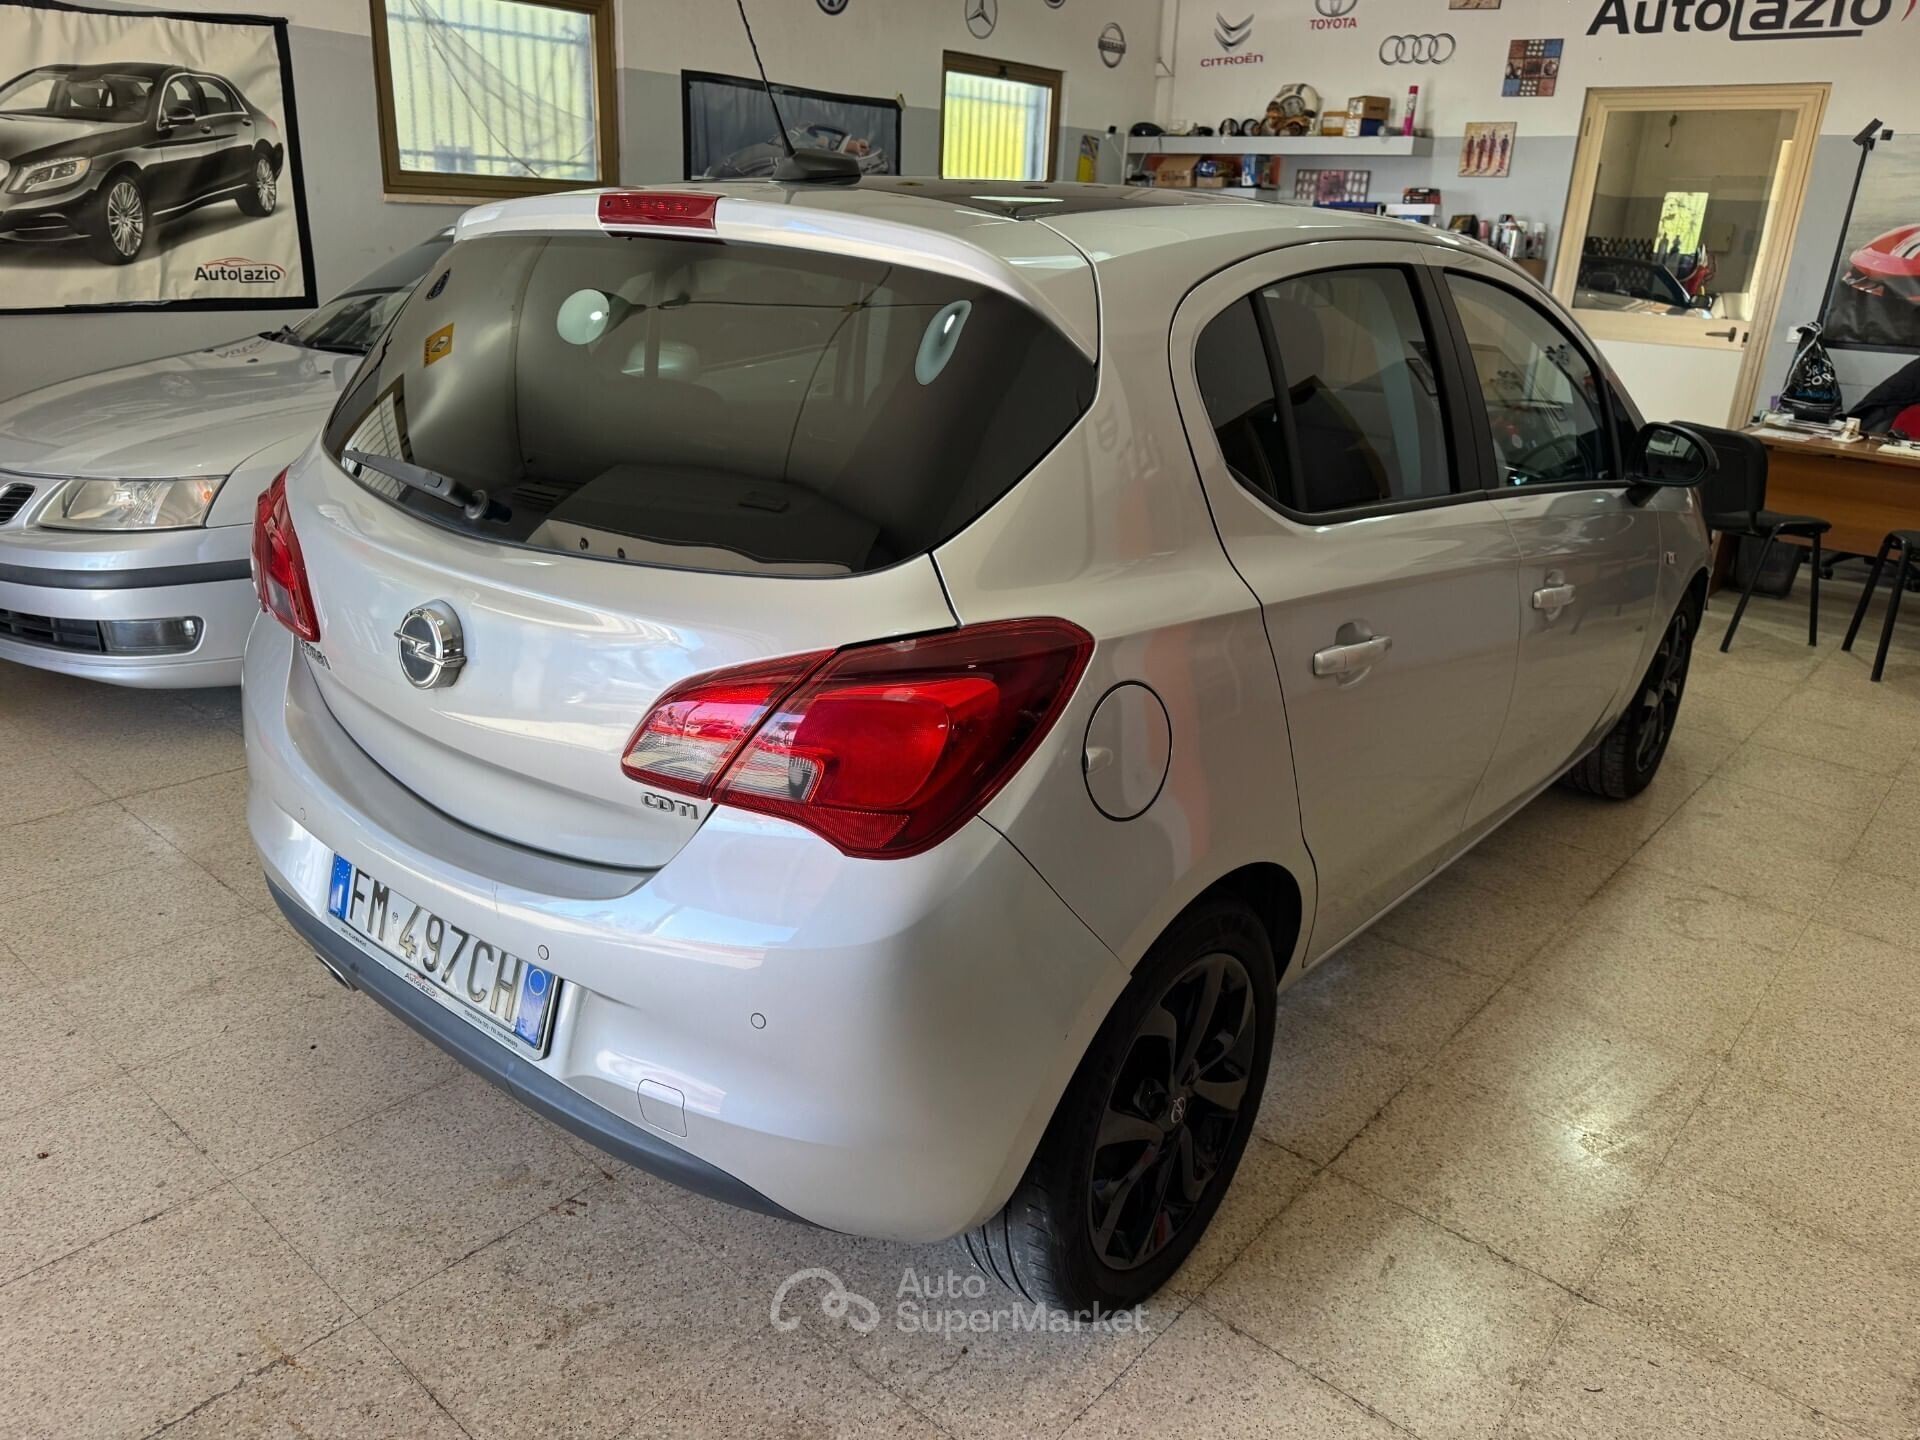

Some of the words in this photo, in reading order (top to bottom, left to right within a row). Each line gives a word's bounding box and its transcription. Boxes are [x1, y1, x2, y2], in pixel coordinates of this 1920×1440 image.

[1310, 17, 1357, 30] TOYOTA
[193, 266, 282, 284] AutoLazio
[350, 868, 389, 941] FM
[399, 905, 524, 1023] 497CH
